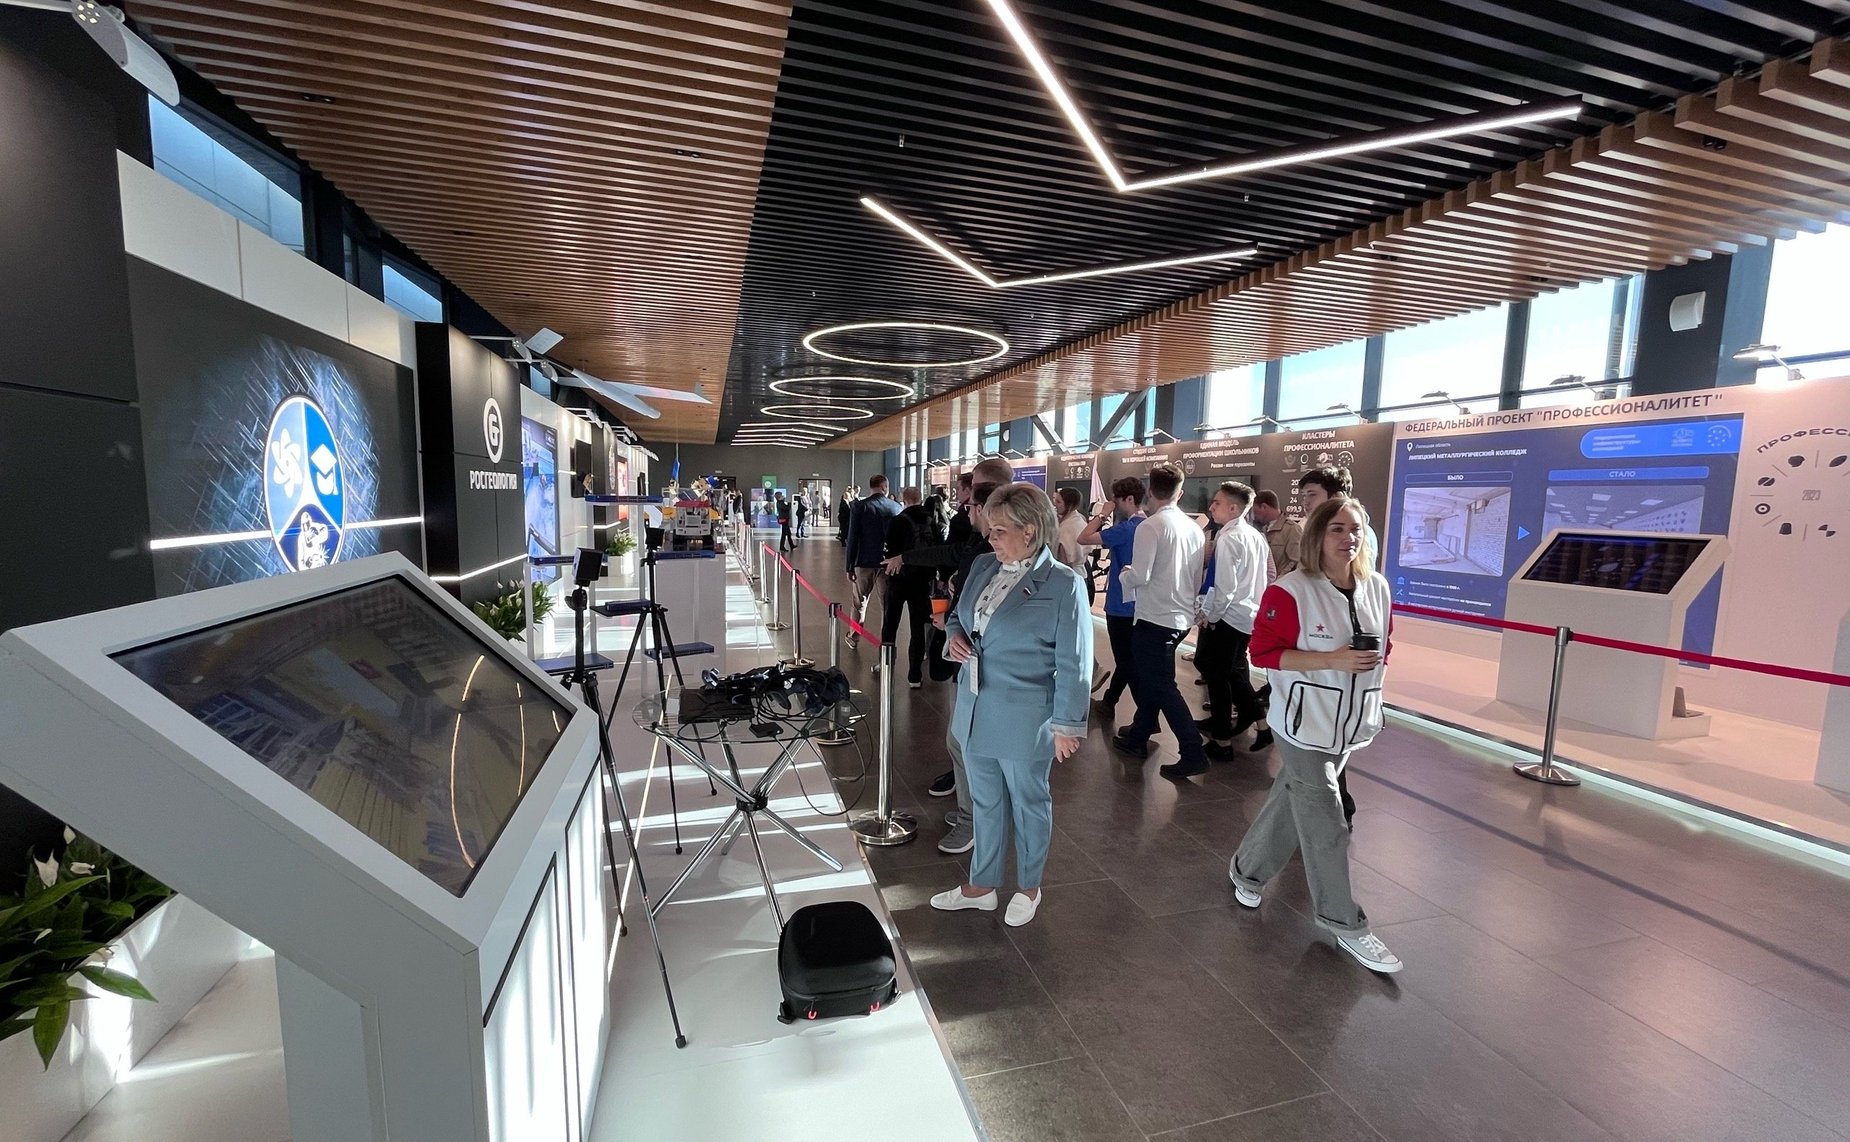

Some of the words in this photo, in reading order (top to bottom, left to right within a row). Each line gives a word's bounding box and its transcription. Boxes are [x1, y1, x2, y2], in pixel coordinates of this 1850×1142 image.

[1405, 415, 1484, 432] ФЕДЕРАЛЬНЫЙ
[1487, 412, 1533, 426] ПРОЕКТ
[1302, 430, 1336, 440] КЛАСТЕРЫ
[1757, 428, 1850, 453] ПРОФЕСС
[1283, 440, 1355, 452] ПРОФЕССИОНАЛИТЕТА
[1436, 449, 1495, 459] МЕТАЛЛУРГИЧЕСКИЙ
[1495, 448, 1527, 457] КОЛЛЕДЖ
[469, 470, 518, 490] РОСГЕОЛОГИЯ
[1609, 470, 1636, 478] СТАЛО
